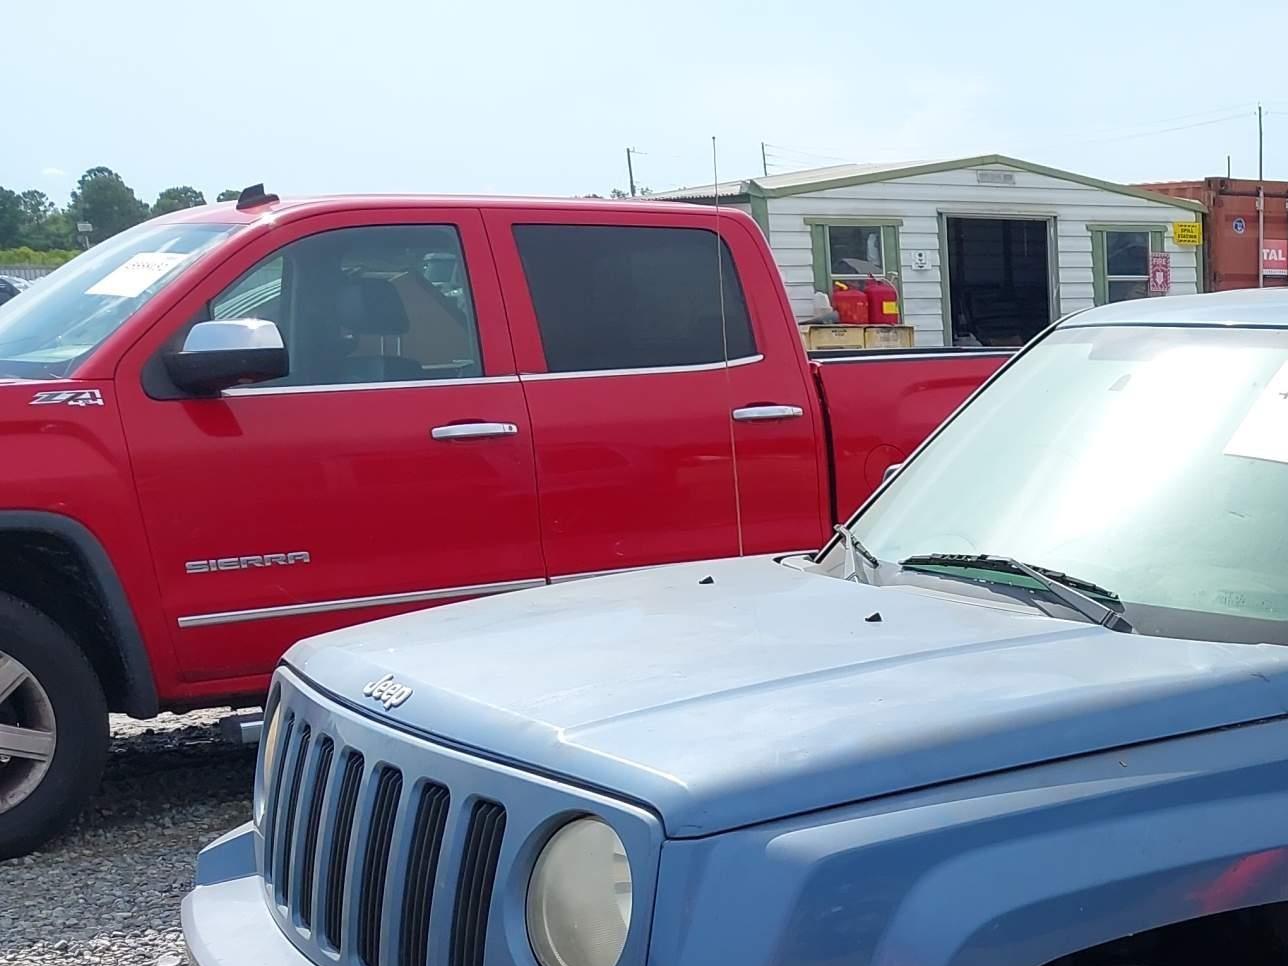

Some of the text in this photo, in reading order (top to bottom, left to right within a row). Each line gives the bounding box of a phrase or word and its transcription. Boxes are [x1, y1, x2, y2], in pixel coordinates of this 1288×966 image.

[1262, 249, 1286, 260] TAL
[185, 551, 310, 573] SIERRA
[363, 673, 414, 712] Jeep
